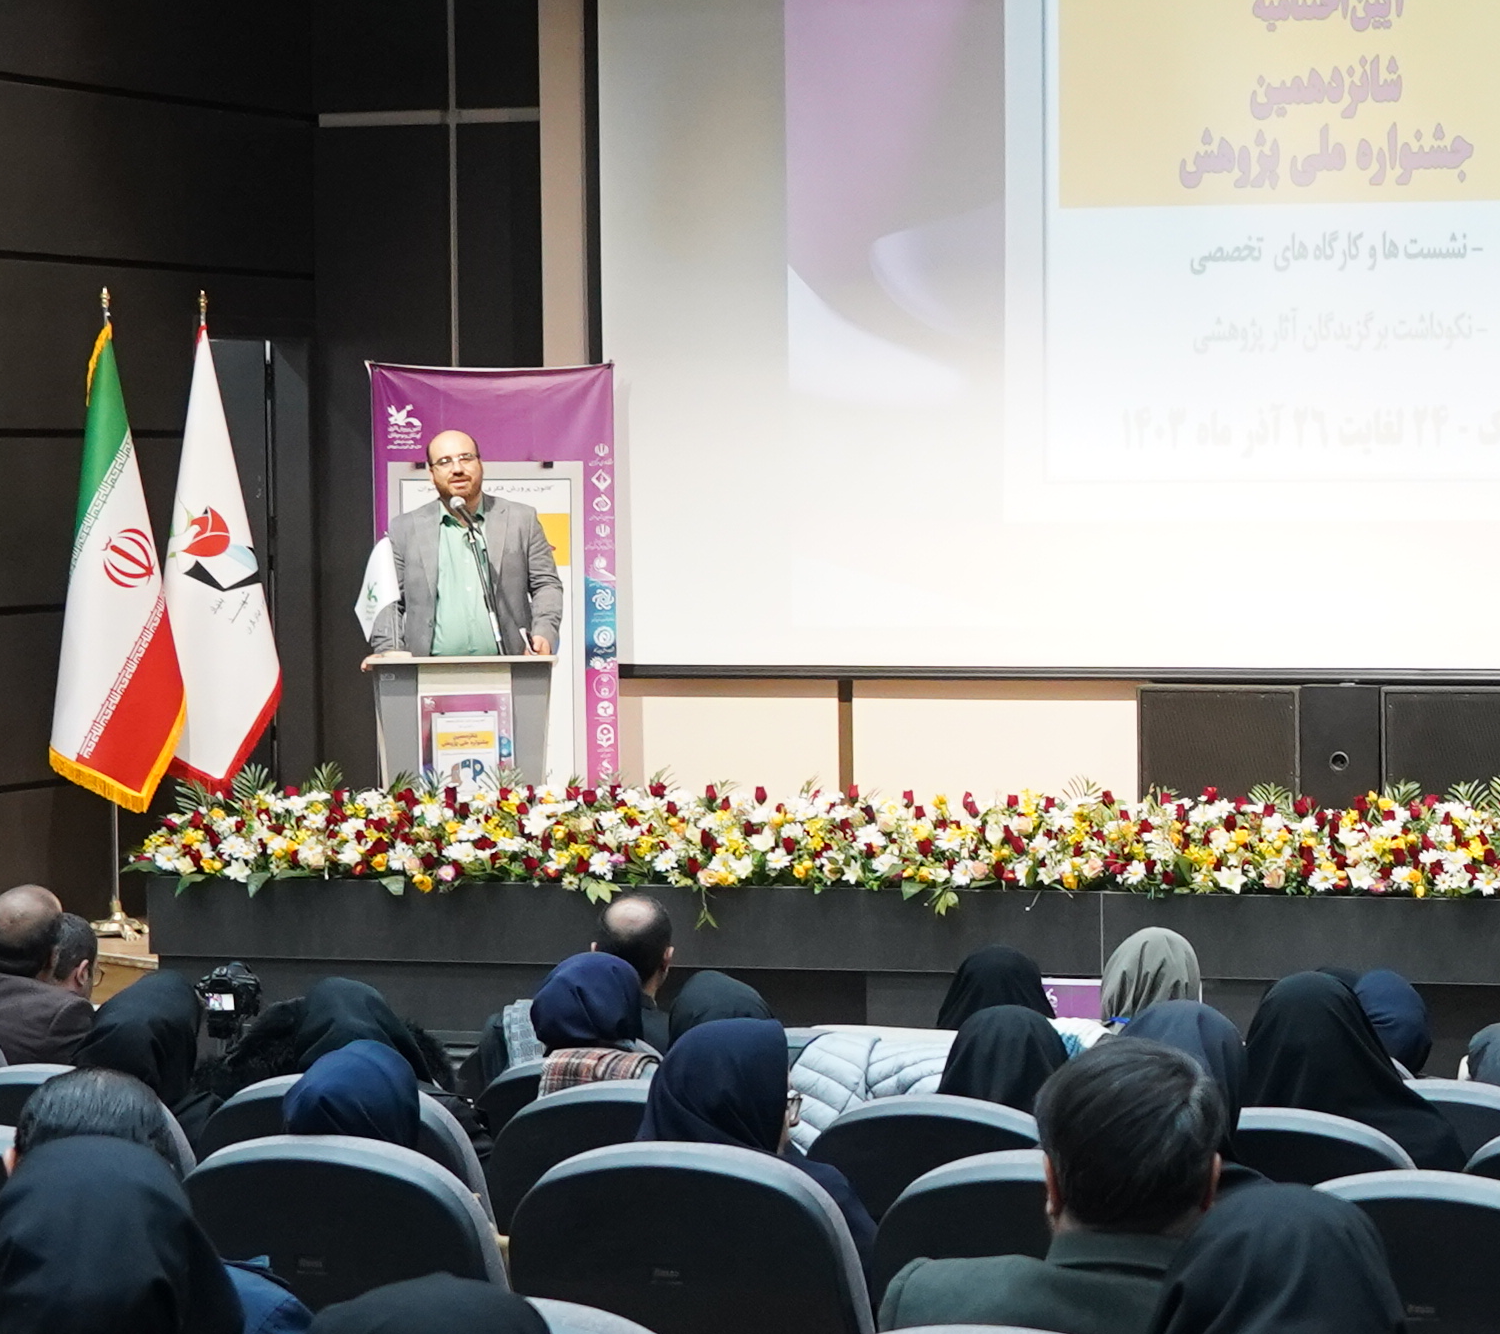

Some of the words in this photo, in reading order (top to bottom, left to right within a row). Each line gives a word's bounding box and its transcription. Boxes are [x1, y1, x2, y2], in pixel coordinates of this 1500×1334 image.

[1250, 54, 1403, 120] شانزدهمین
[1179, 127, 1280, 190] پژوهش
[1289, 122, 1347, 188] ملی
[1356, 122, 1475, 185] جشنواره
[1190, 235, 1264, 276] تخصصی
[1313, 231, 1363, 271] کارگاه
